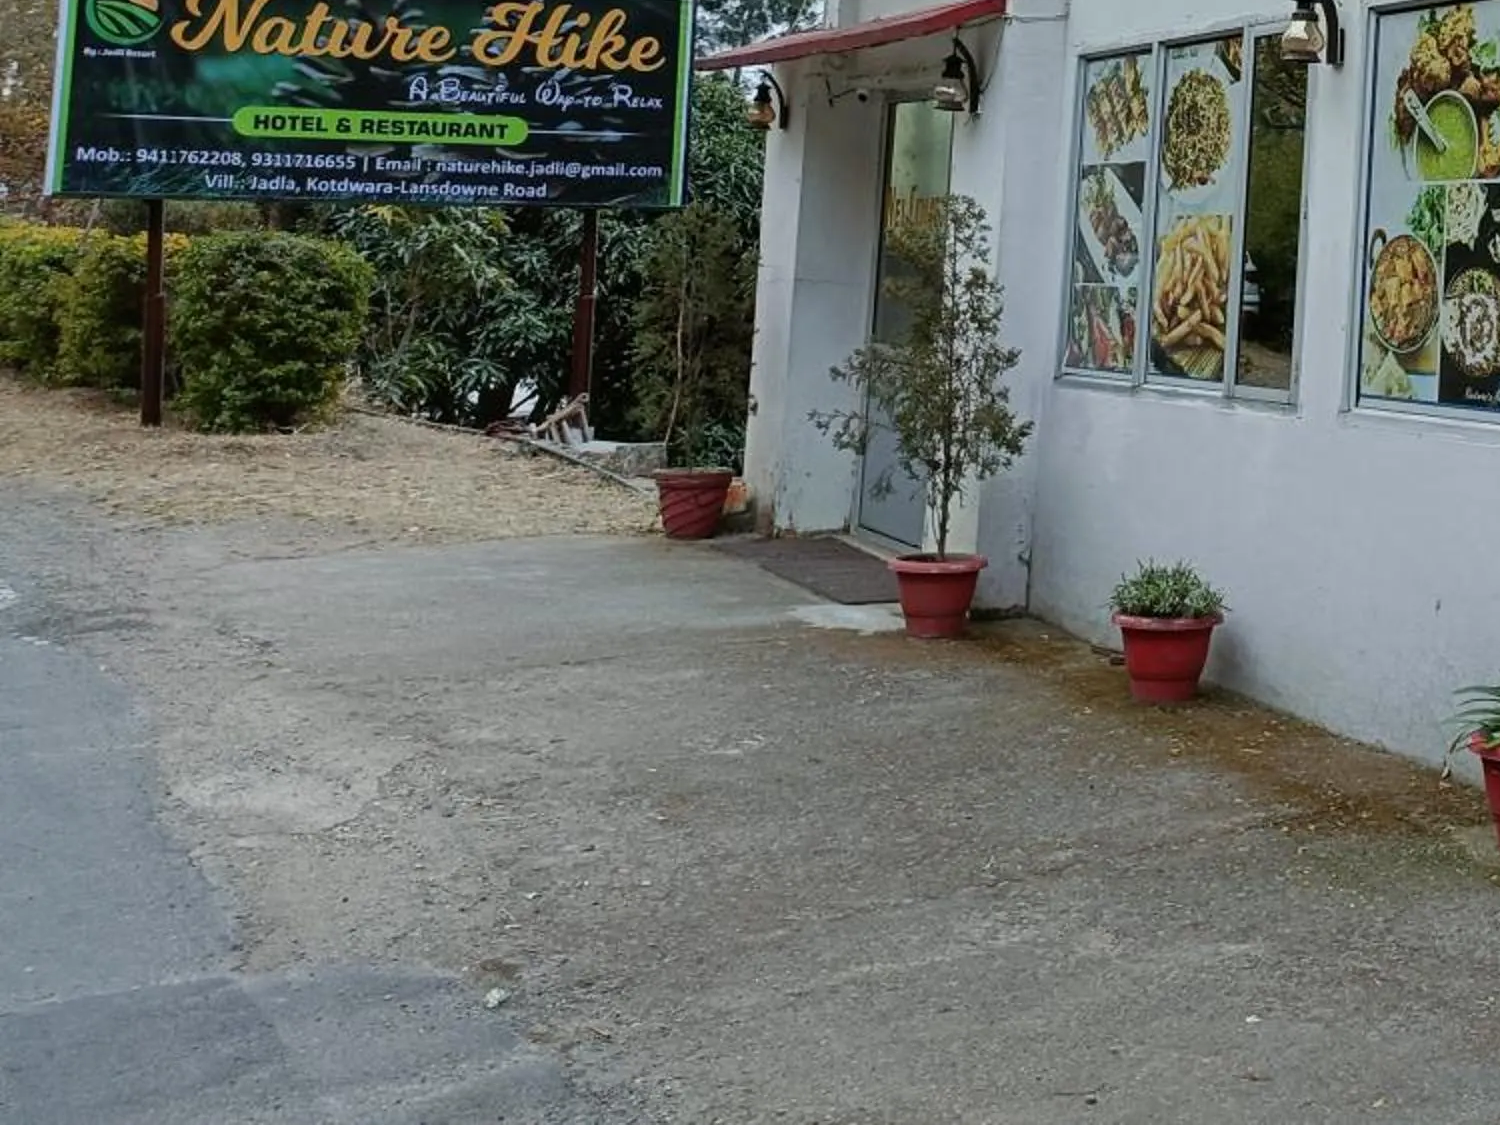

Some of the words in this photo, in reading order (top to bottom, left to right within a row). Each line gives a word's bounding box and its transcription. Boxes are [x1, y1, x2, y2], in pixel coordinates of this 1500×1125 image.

[471, 0, 667, 72] Hike
[409, 76, 428, 102] A
[253, 114, 329, 133] HOTEL
[335, 117, 351, 134] &
[360, 118, 509, 140] RESTAURANT
[251, 152, 356, 169] 9311716655
[375, 156, 421, 172] Email
[435, 159, 662, 179] naturehike.jadli@gmail.com
[306, 177, 499, 197] Kotdwara-Lansdowne
[504, 182, 547, 199] Road
